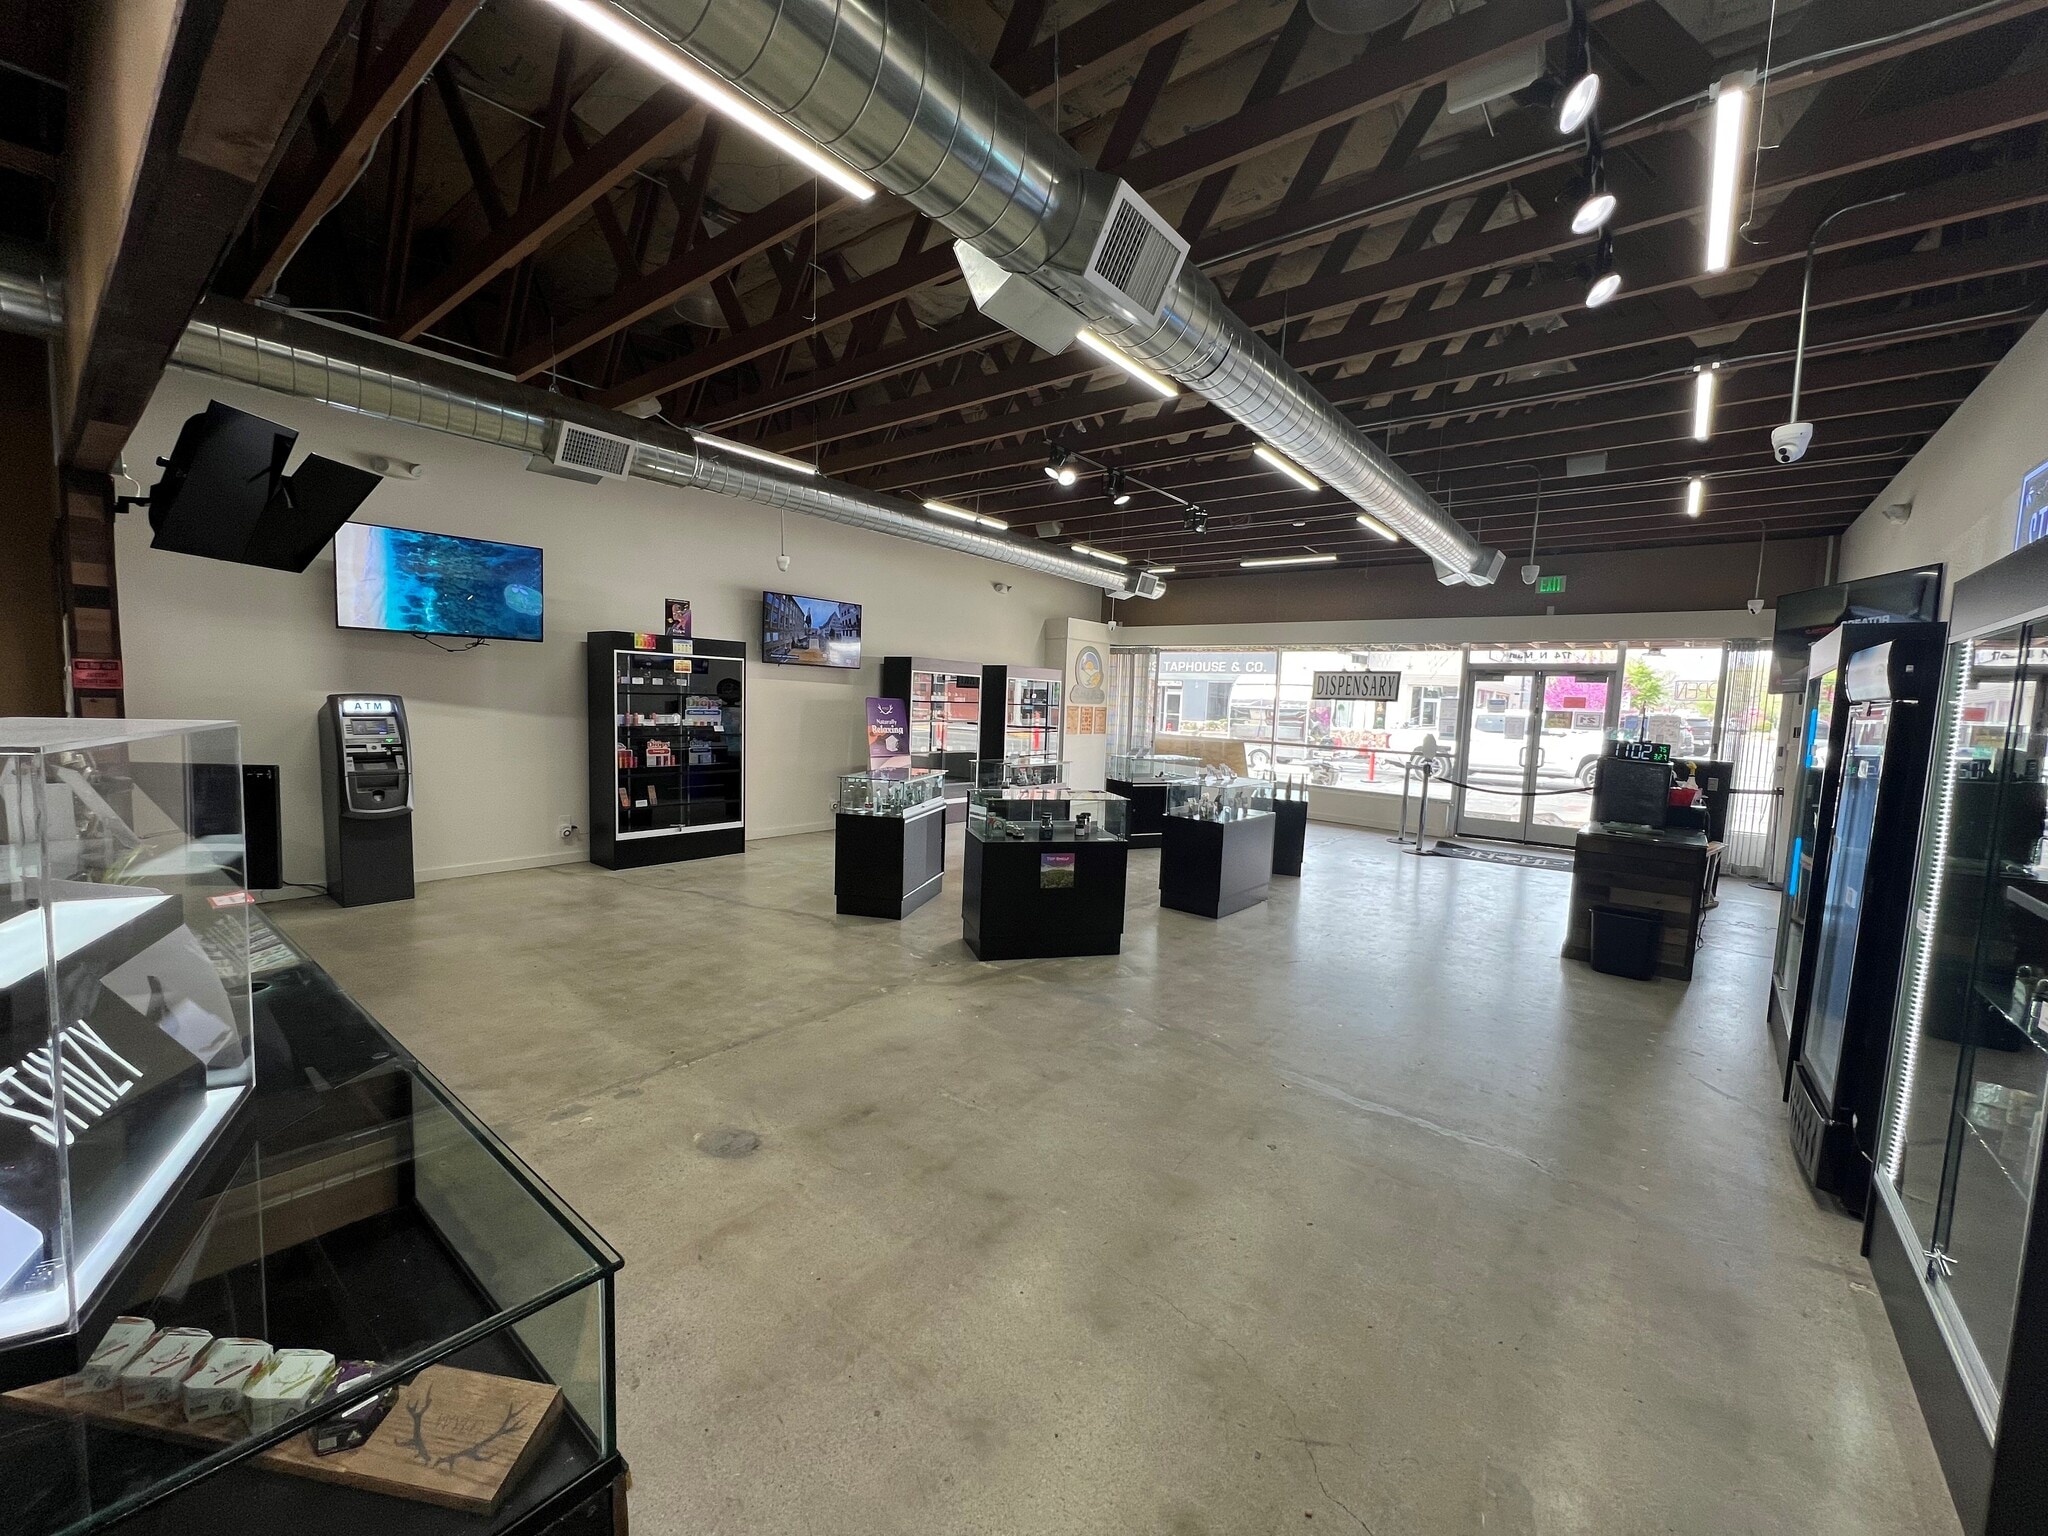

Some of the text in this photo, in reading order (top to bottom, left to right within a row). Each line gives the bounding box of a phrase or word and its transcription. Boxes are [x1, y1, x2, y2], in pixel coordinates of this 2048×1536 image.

[1540, 576, 1562, 592] EXIT
[1164, 662, 1226, 672] TAPHOUSE
[1231, 662, 1241, 672] &
[1245, 662, 1267, 672] CO.
[1317, 675, 1395, 696] DISPENSARY
[354, 702, 382, 710] ATM
[876, 719, 897, 727] Naturally
[872, 725, 904, 735] Relaxing
